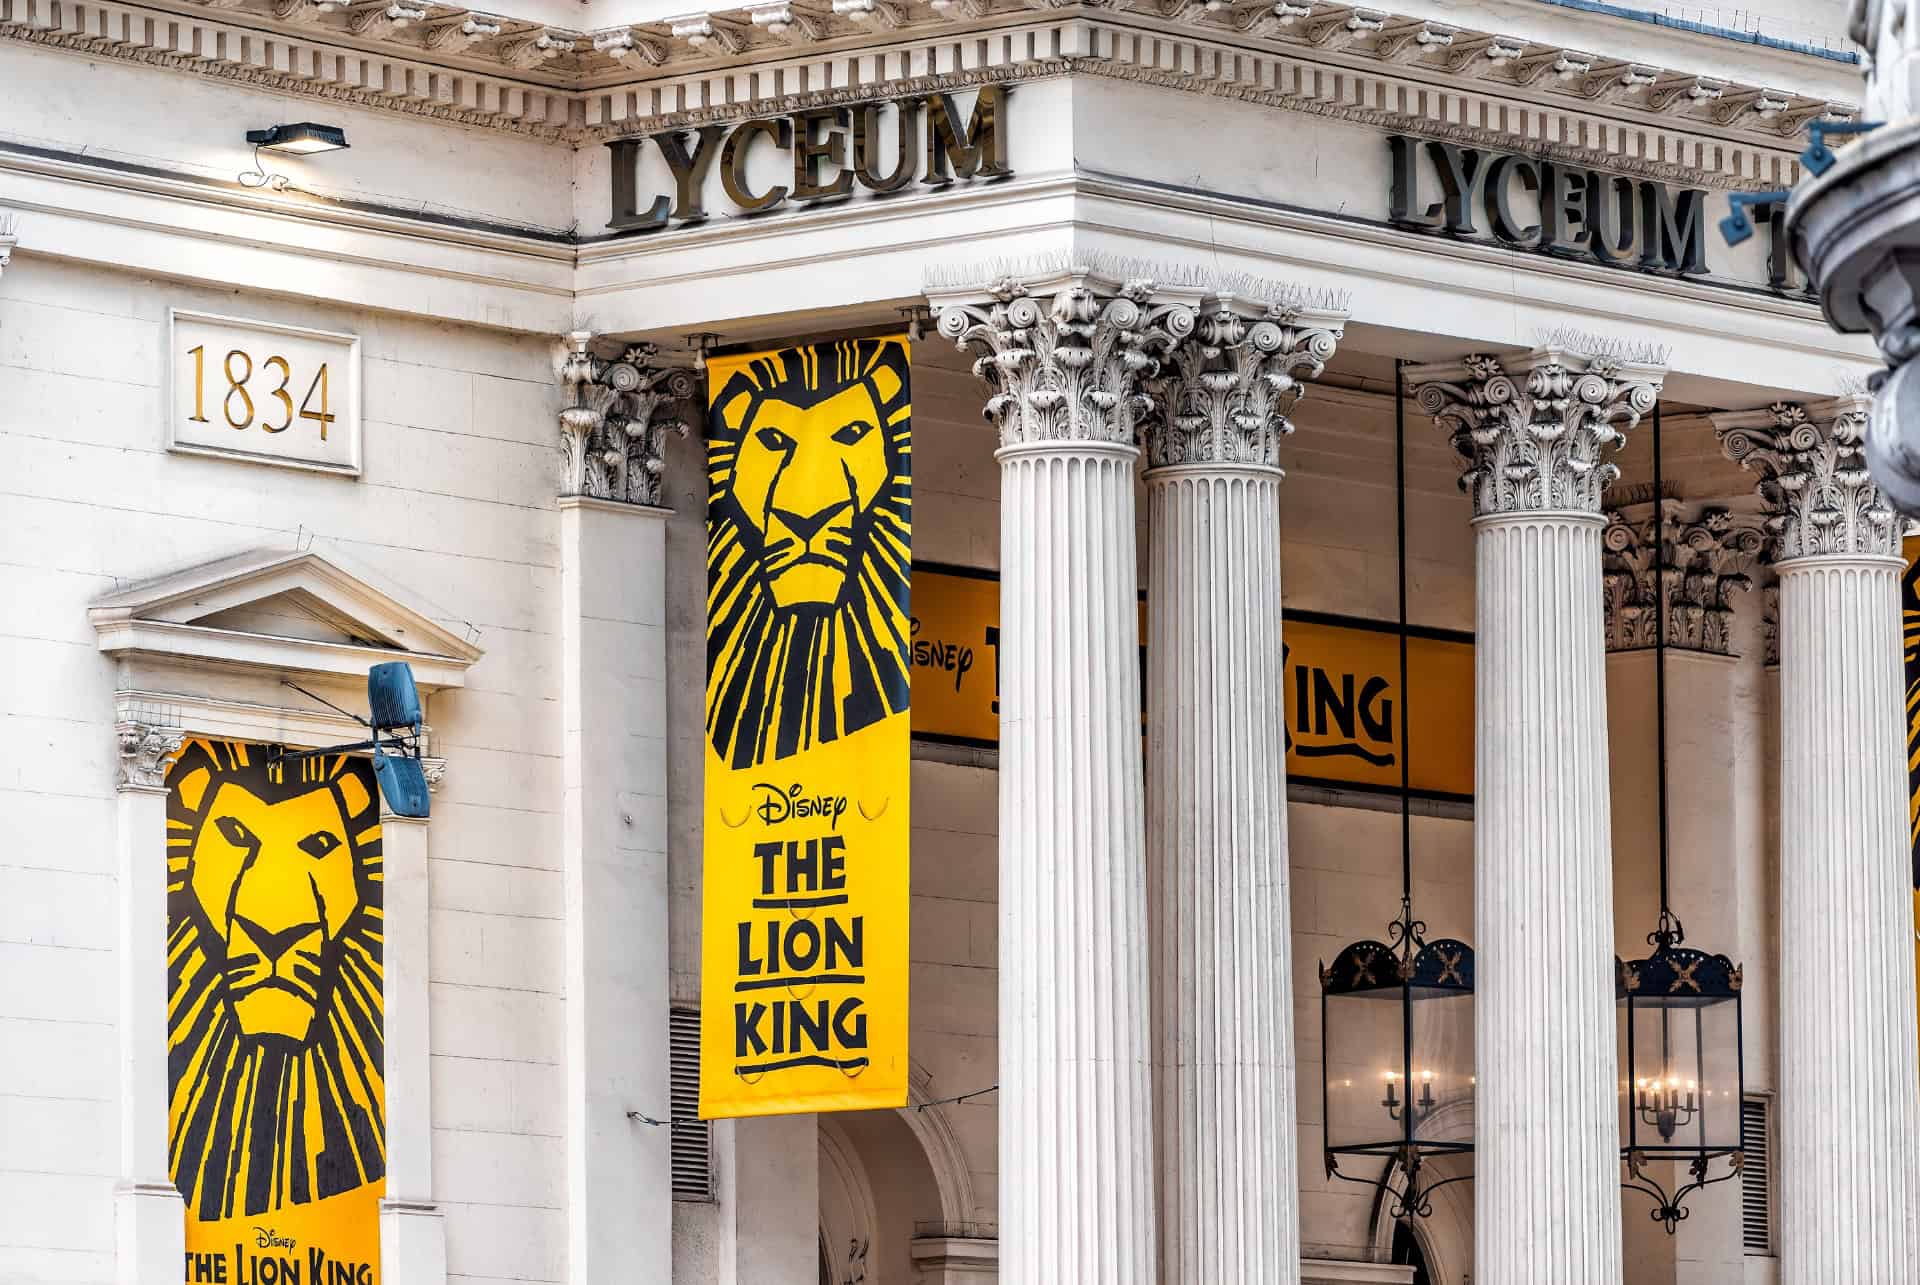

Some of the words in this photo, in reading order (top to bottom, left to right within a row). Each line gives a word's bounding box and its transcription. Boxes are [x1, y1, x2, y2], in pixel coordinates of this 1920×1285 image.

[605, 84, 1015, 231] LYCEUM
[1387, 134, 1712, 276] LYCEUM
[187, 344, 336, 442] 1834
[1281, 640, 1393, 753] ING
[753, 835, 847, 895] THE
[738, 916, 864, 976] LION
[735, 997, 868, 1058] KING
